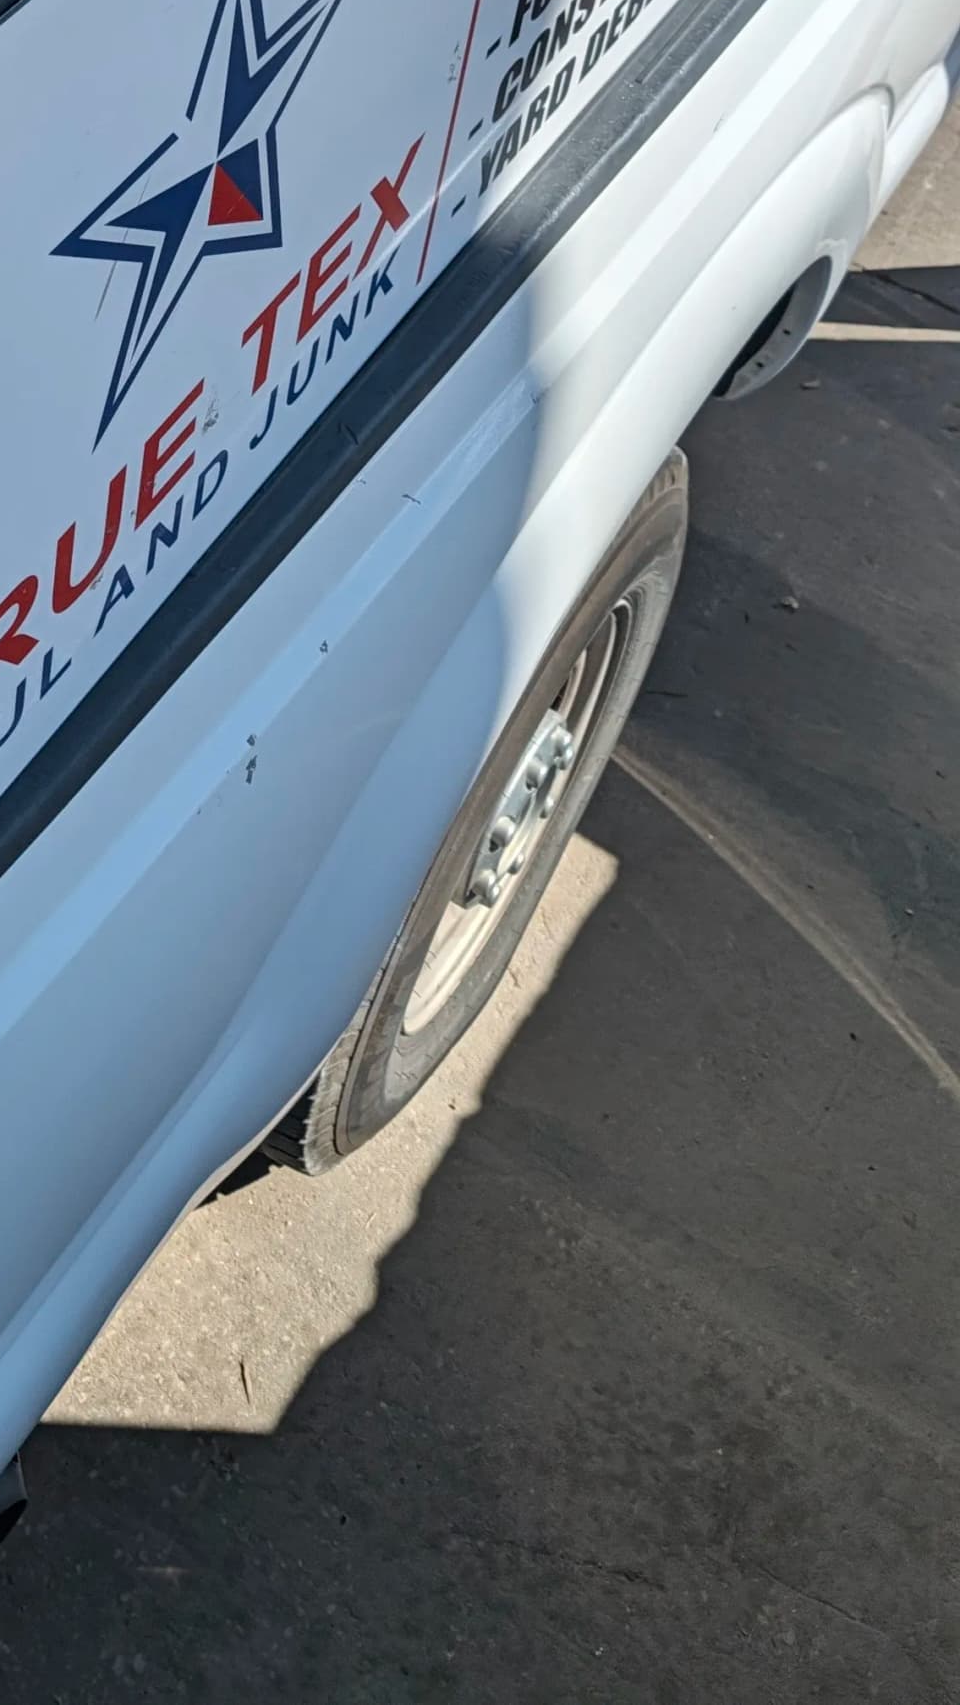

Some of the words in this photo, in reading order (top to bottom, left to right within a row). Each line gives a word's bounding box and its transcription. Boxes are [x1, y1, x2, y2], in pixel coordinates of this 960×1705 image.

[478, 55, 577, 198] YARD
[241, 132, 426, 393] TEX
[93, 449, 228, 640] AND
[249, 248, 402, 450] JUNK
